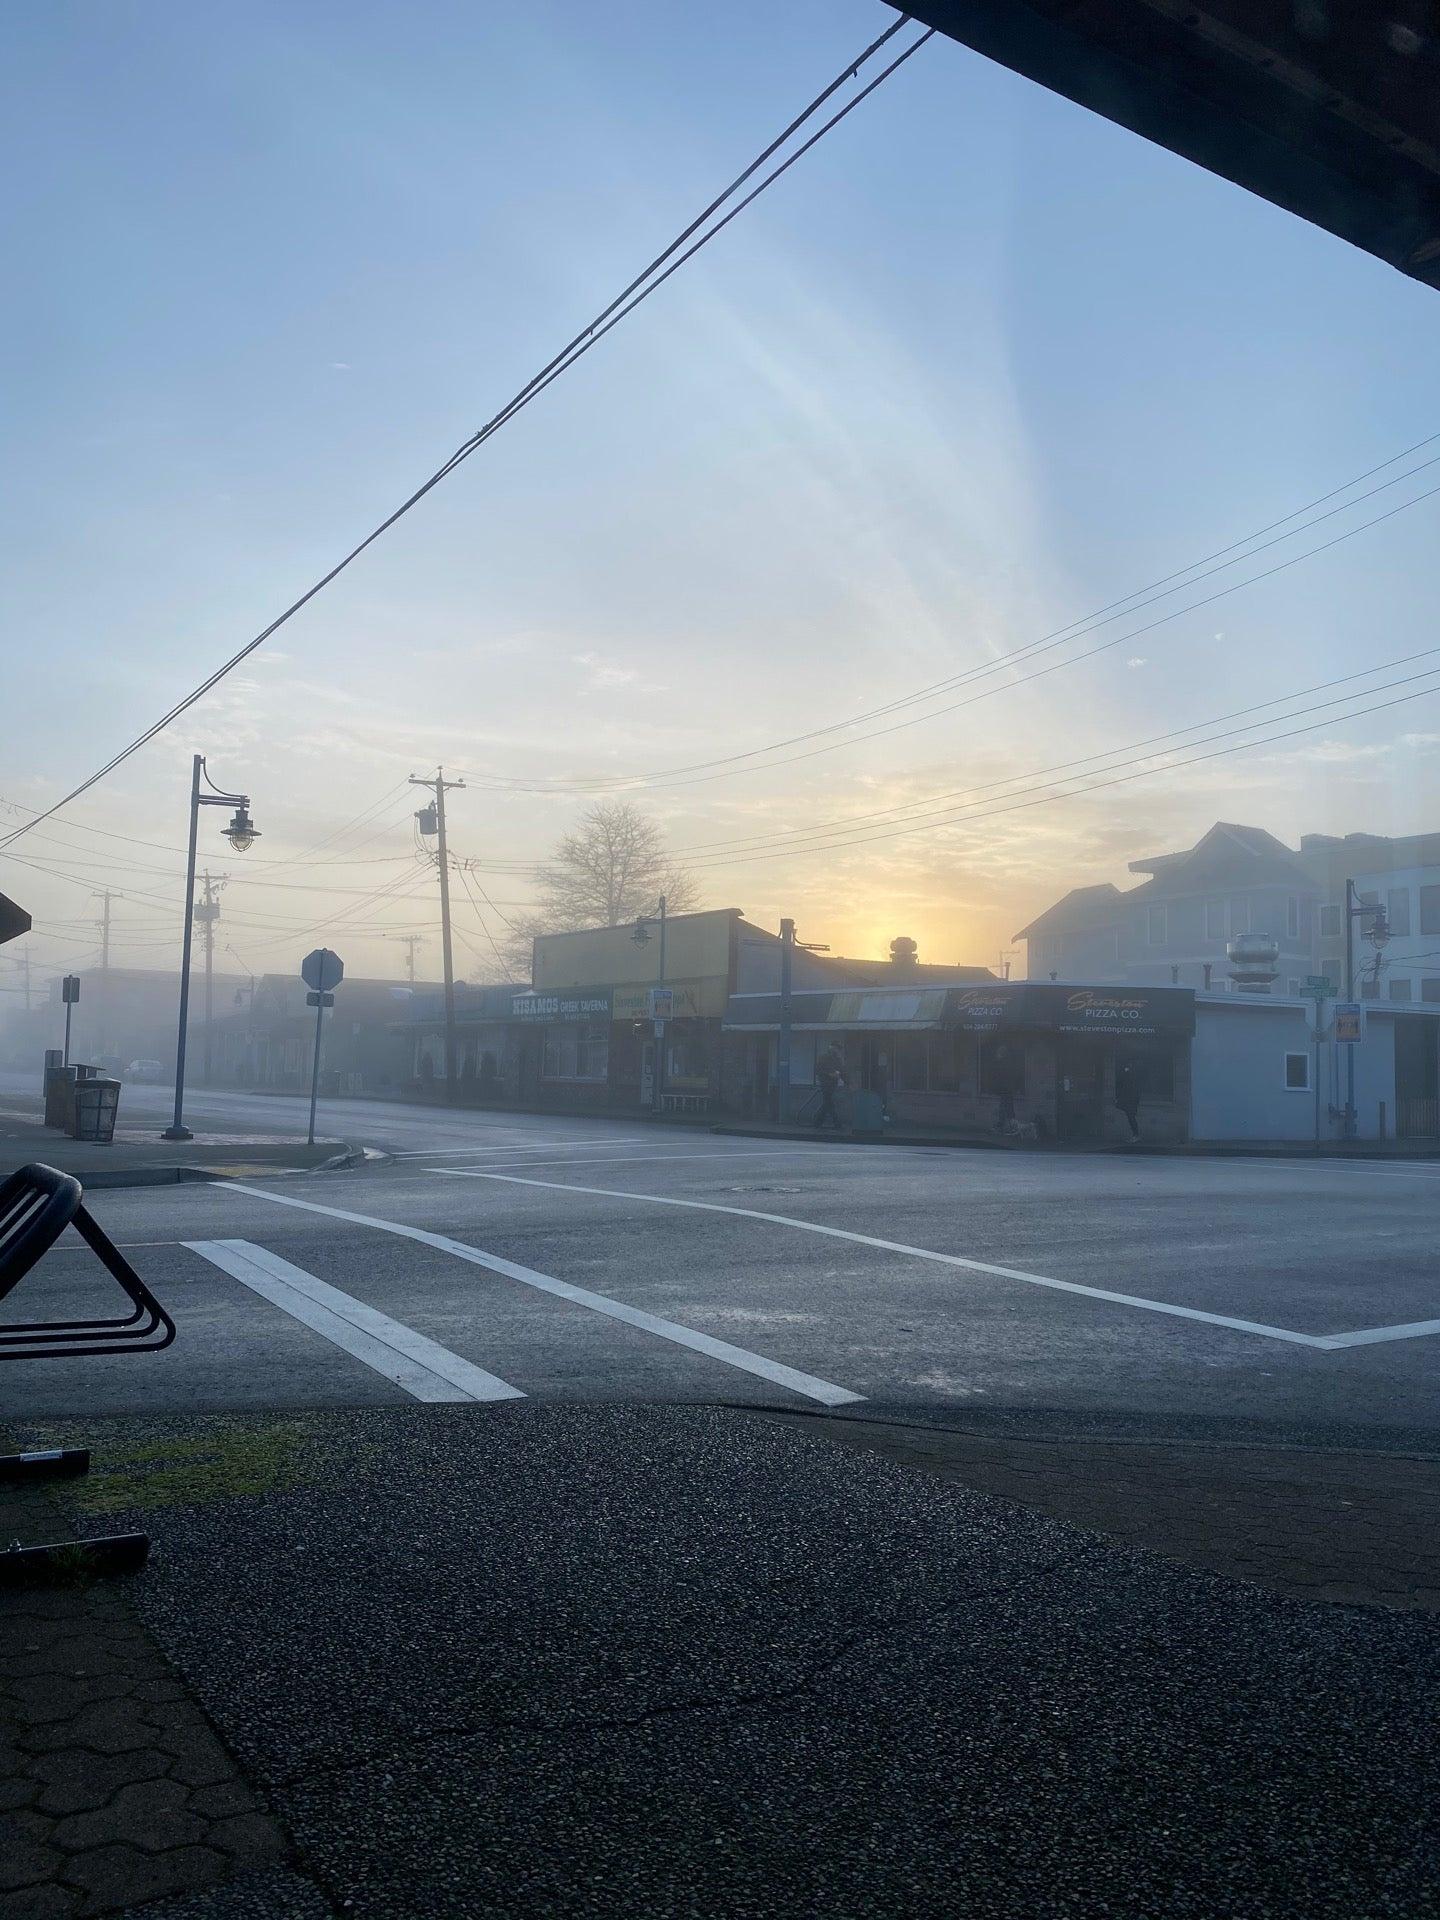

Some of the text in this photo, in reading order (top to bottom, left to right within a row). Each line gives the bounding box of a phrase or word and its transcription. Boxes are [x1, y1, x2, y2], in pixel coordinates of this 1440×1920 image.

[968, 1008, 988, 1016] PIZZA
[1085, 1009, 1143, 1019] PIZZA CO.
[1059, 1025, 1155, 1034] www.stevestonpizza.com
